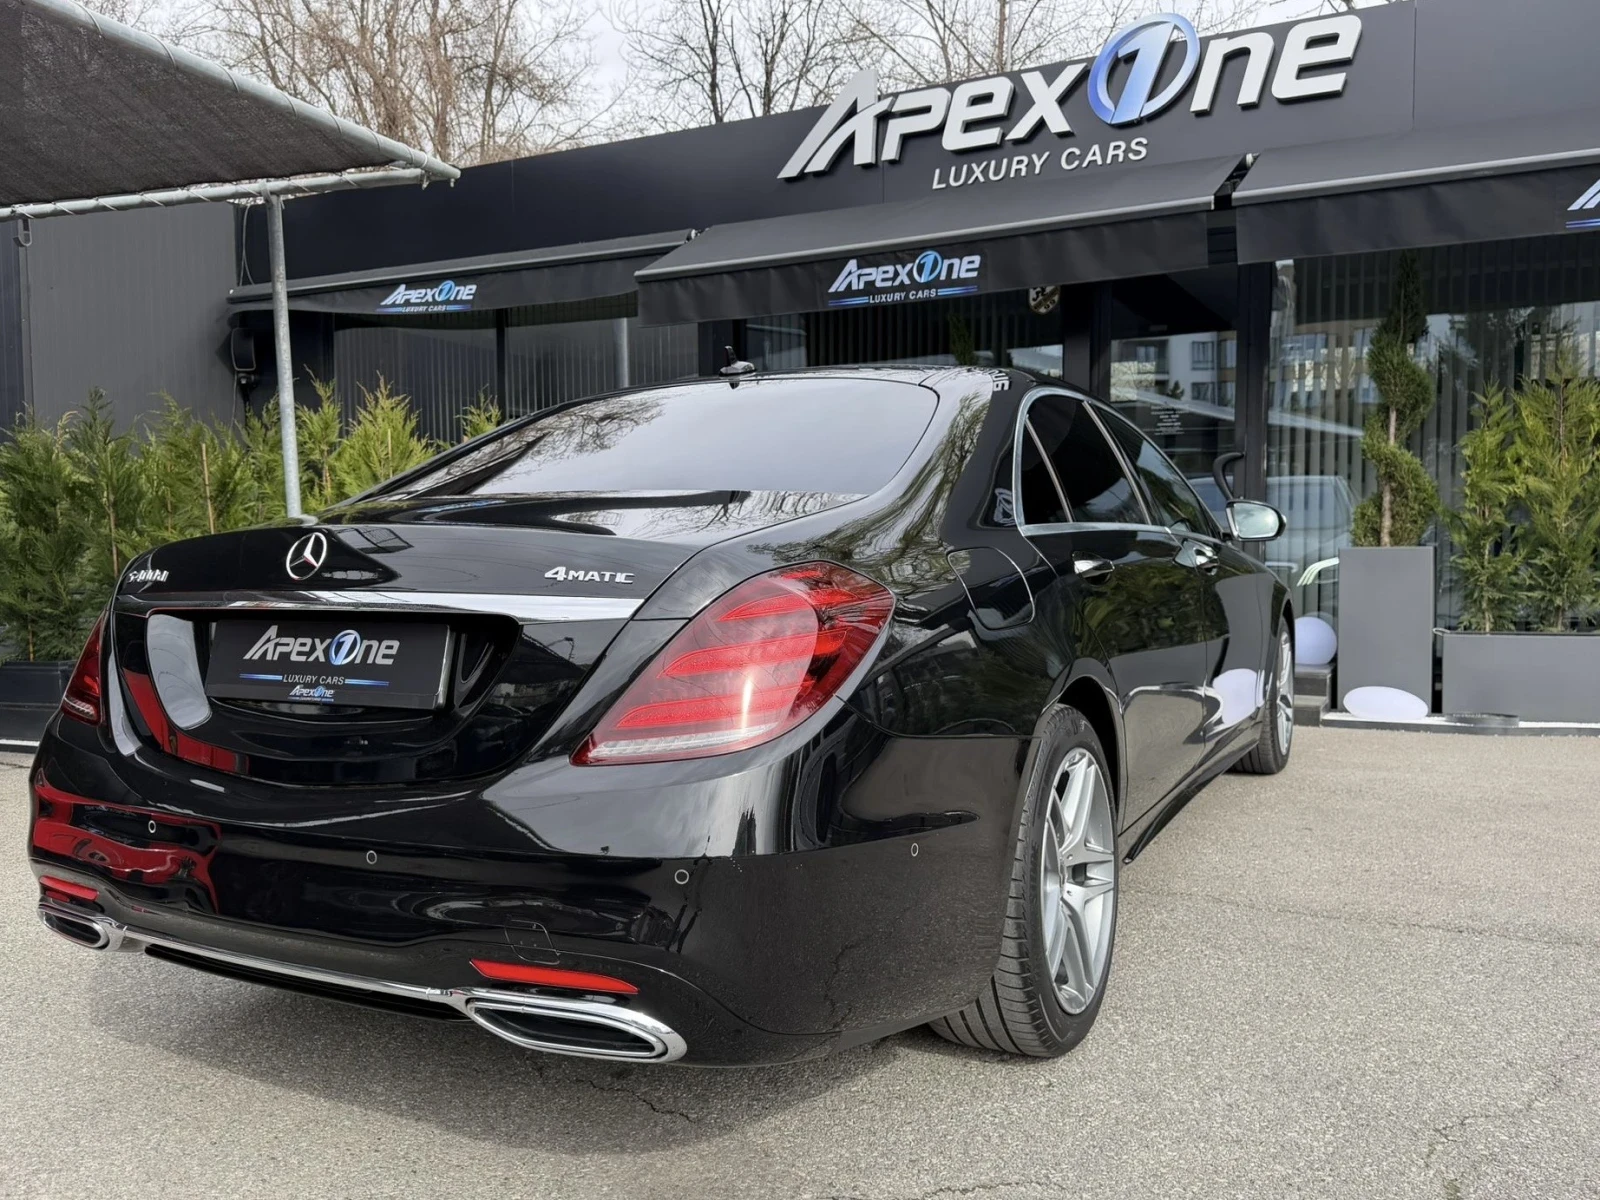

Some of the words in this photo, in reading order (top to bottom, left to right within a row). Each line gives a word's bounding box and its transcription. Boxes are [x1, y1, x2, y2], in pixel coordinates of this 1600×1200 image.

[932, 150, 1051, 190] LUXURY
[1060, 137, 1149, 171] CARS
[869, 292, 905, 304] LUXURY
[909, 288, 937, 300] CARS
[428, 304, 447, 312] CARS
[544, 566, 636, 584] 4MATIC
[283, 674, 317, 684] LUXURY
[319, 675, 345, 686] CARS
